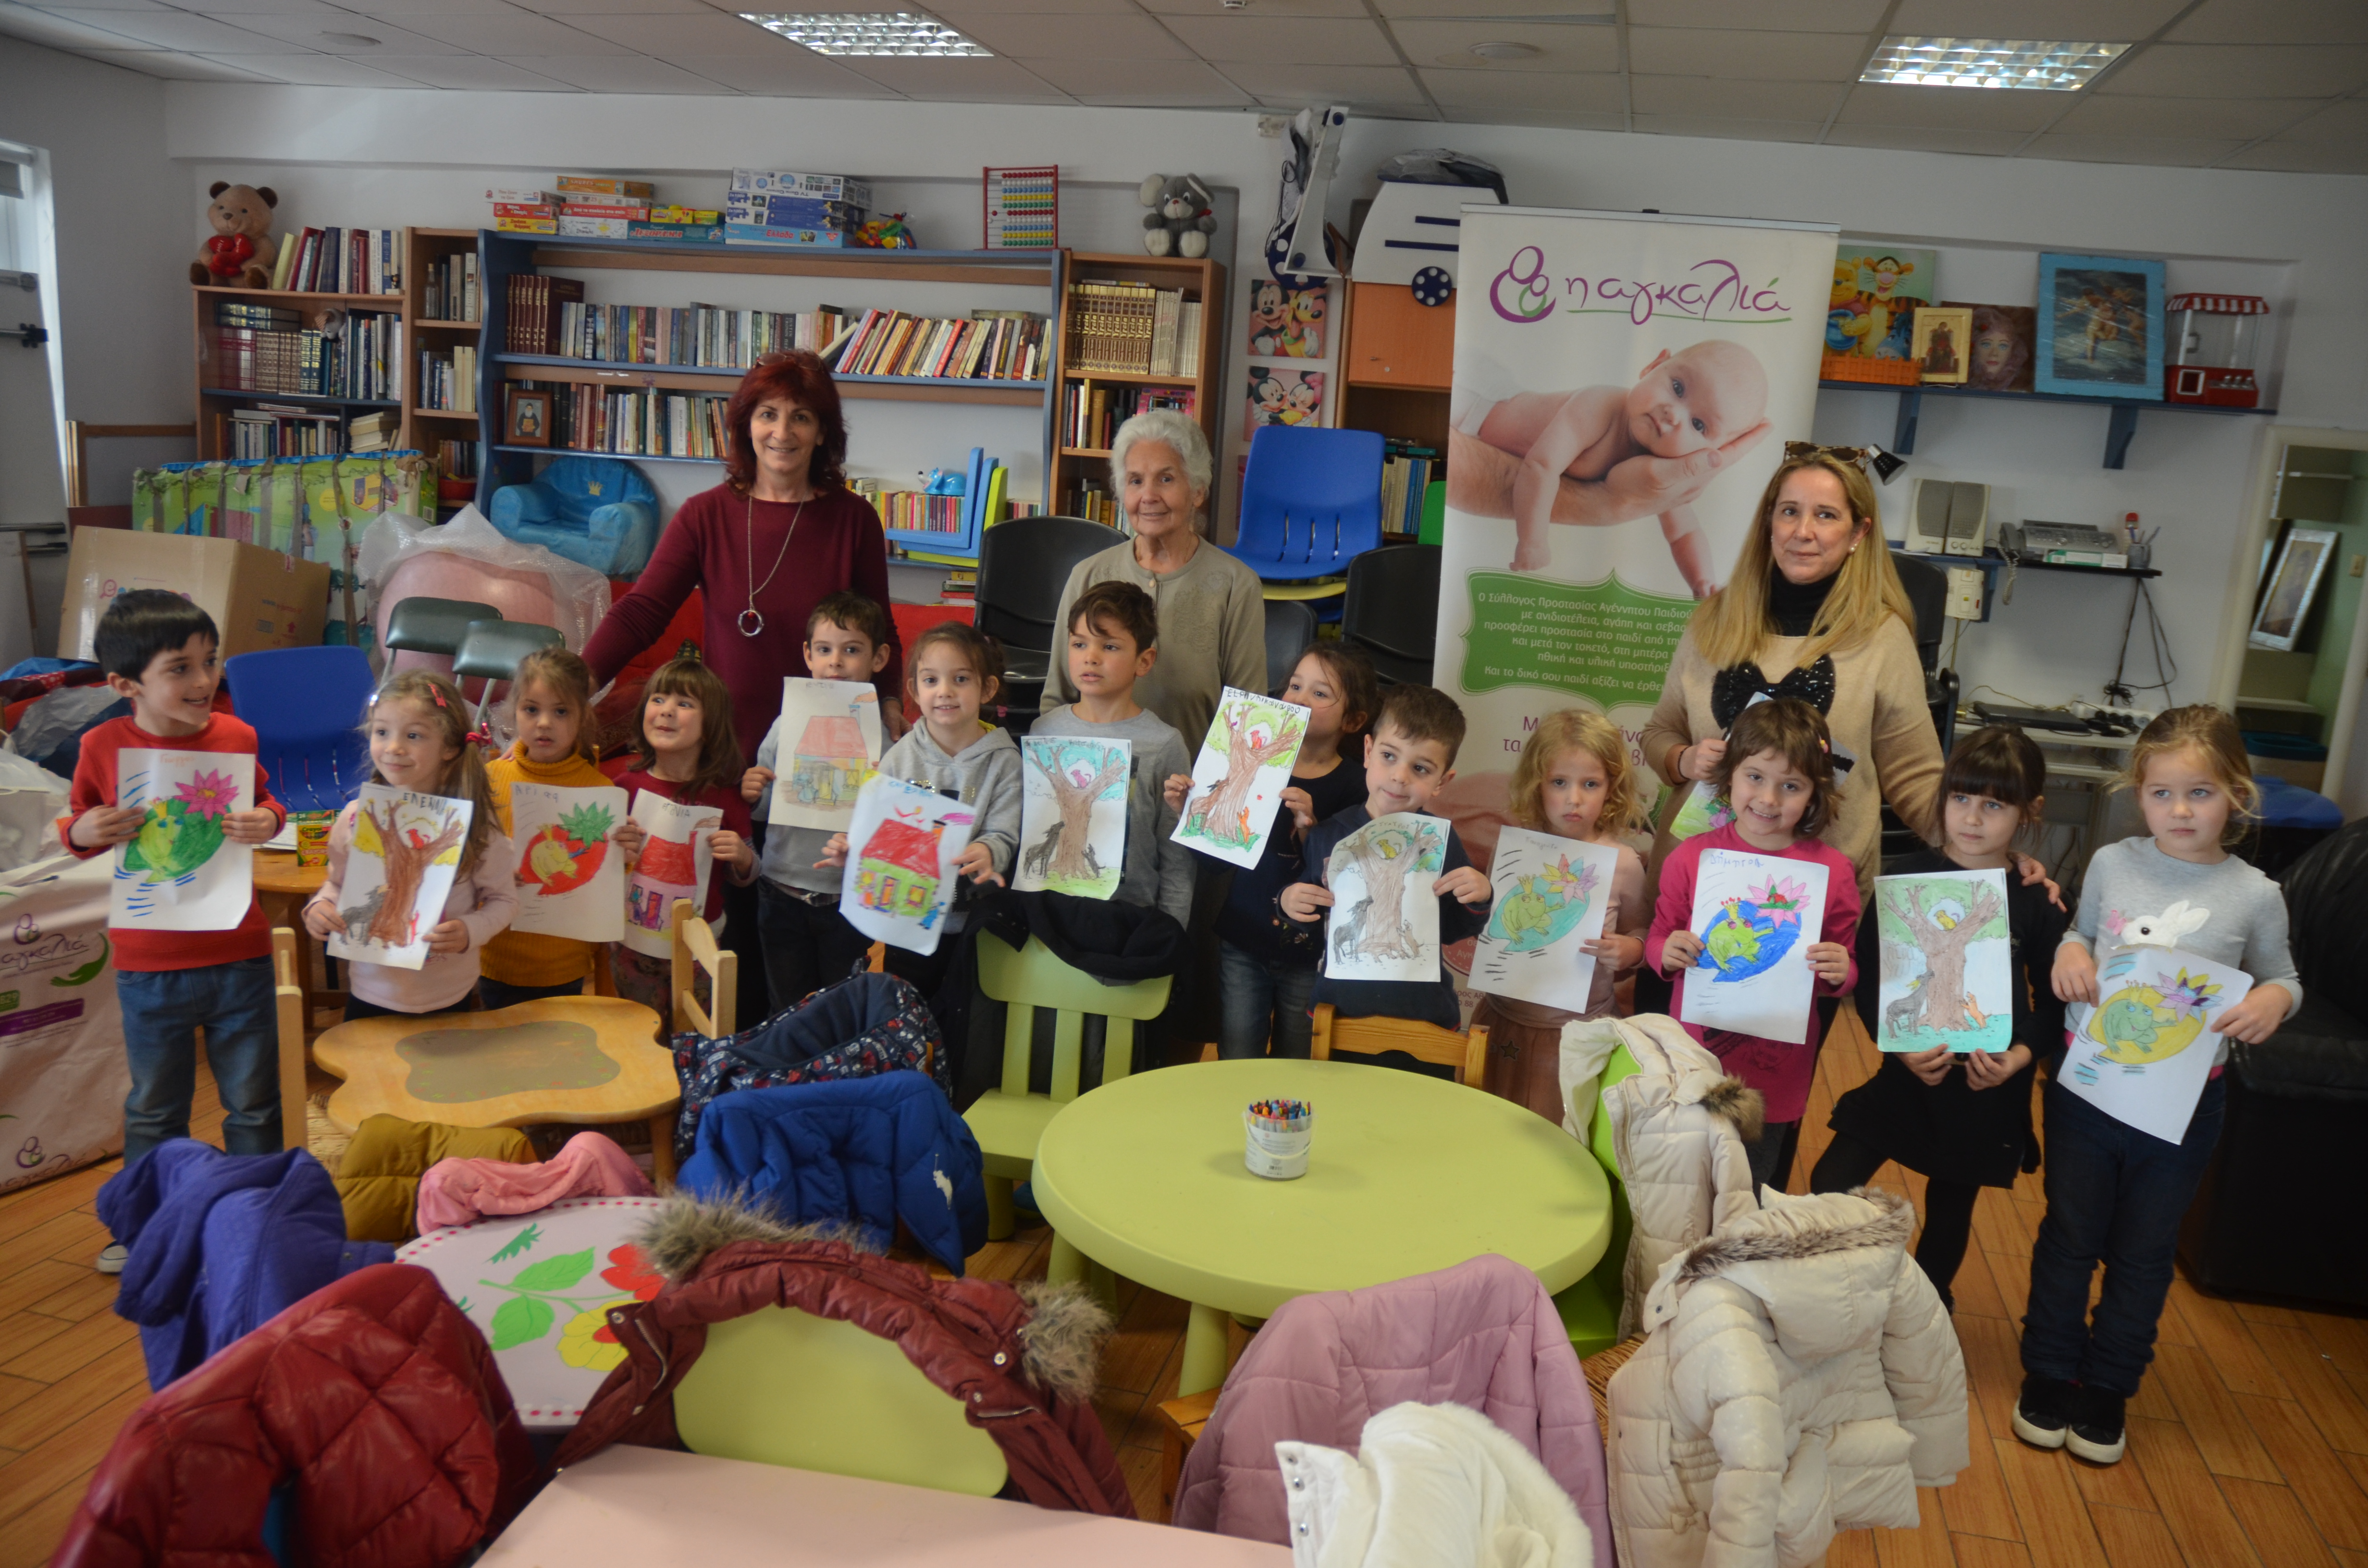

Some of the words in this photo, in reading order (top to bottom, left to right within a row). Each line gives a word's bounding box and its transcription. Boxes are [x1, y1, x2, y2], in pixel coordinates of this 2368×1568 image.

[1479, 593, 1485, 601] Ο
[1489, 593, 1536, 606] Σύλλογος
[1539, 597, 1596, 612] Προστασίας
[1521, 611, 1533, 620] με
[1536, 612, 1599, 625] ανιδιοτέλεια,
[1603, 617, 1633, 628] αγάπη
[1637, 622, 1652, 630] και
[1484, 622, 1537, 634] προσφέρει
[1541, 626, 1592, 638] προστασία
[1596, 631, 1613, 639] στο
[1616, 633, 1641, 643] παιδί
[1644, 635, 1664, 644] από
[1531, 639, 1553, 648] μετά
[1556, 641, 1572, 649] τον
[1575, 642, 1610, 654] τοκετό,
[1614, 647, 1630, 655] στη
[1633, 649, 1668, 660] μητέρα
[1538, 651, 1566, 662] ηθική
[1569, 656, 1584, 664] και
[1588, 656, 1615, 667] υλική
[1485, 666, 1500, 675] Και
[1504, 668, 1514, 676] το
[1517, 668, 1539, 679] δικό
[1542, 673, 1561, 681] σου
[1564, 674, 1589, 684] παιδί
[1592, 676, 1618, 687] αξίζει
